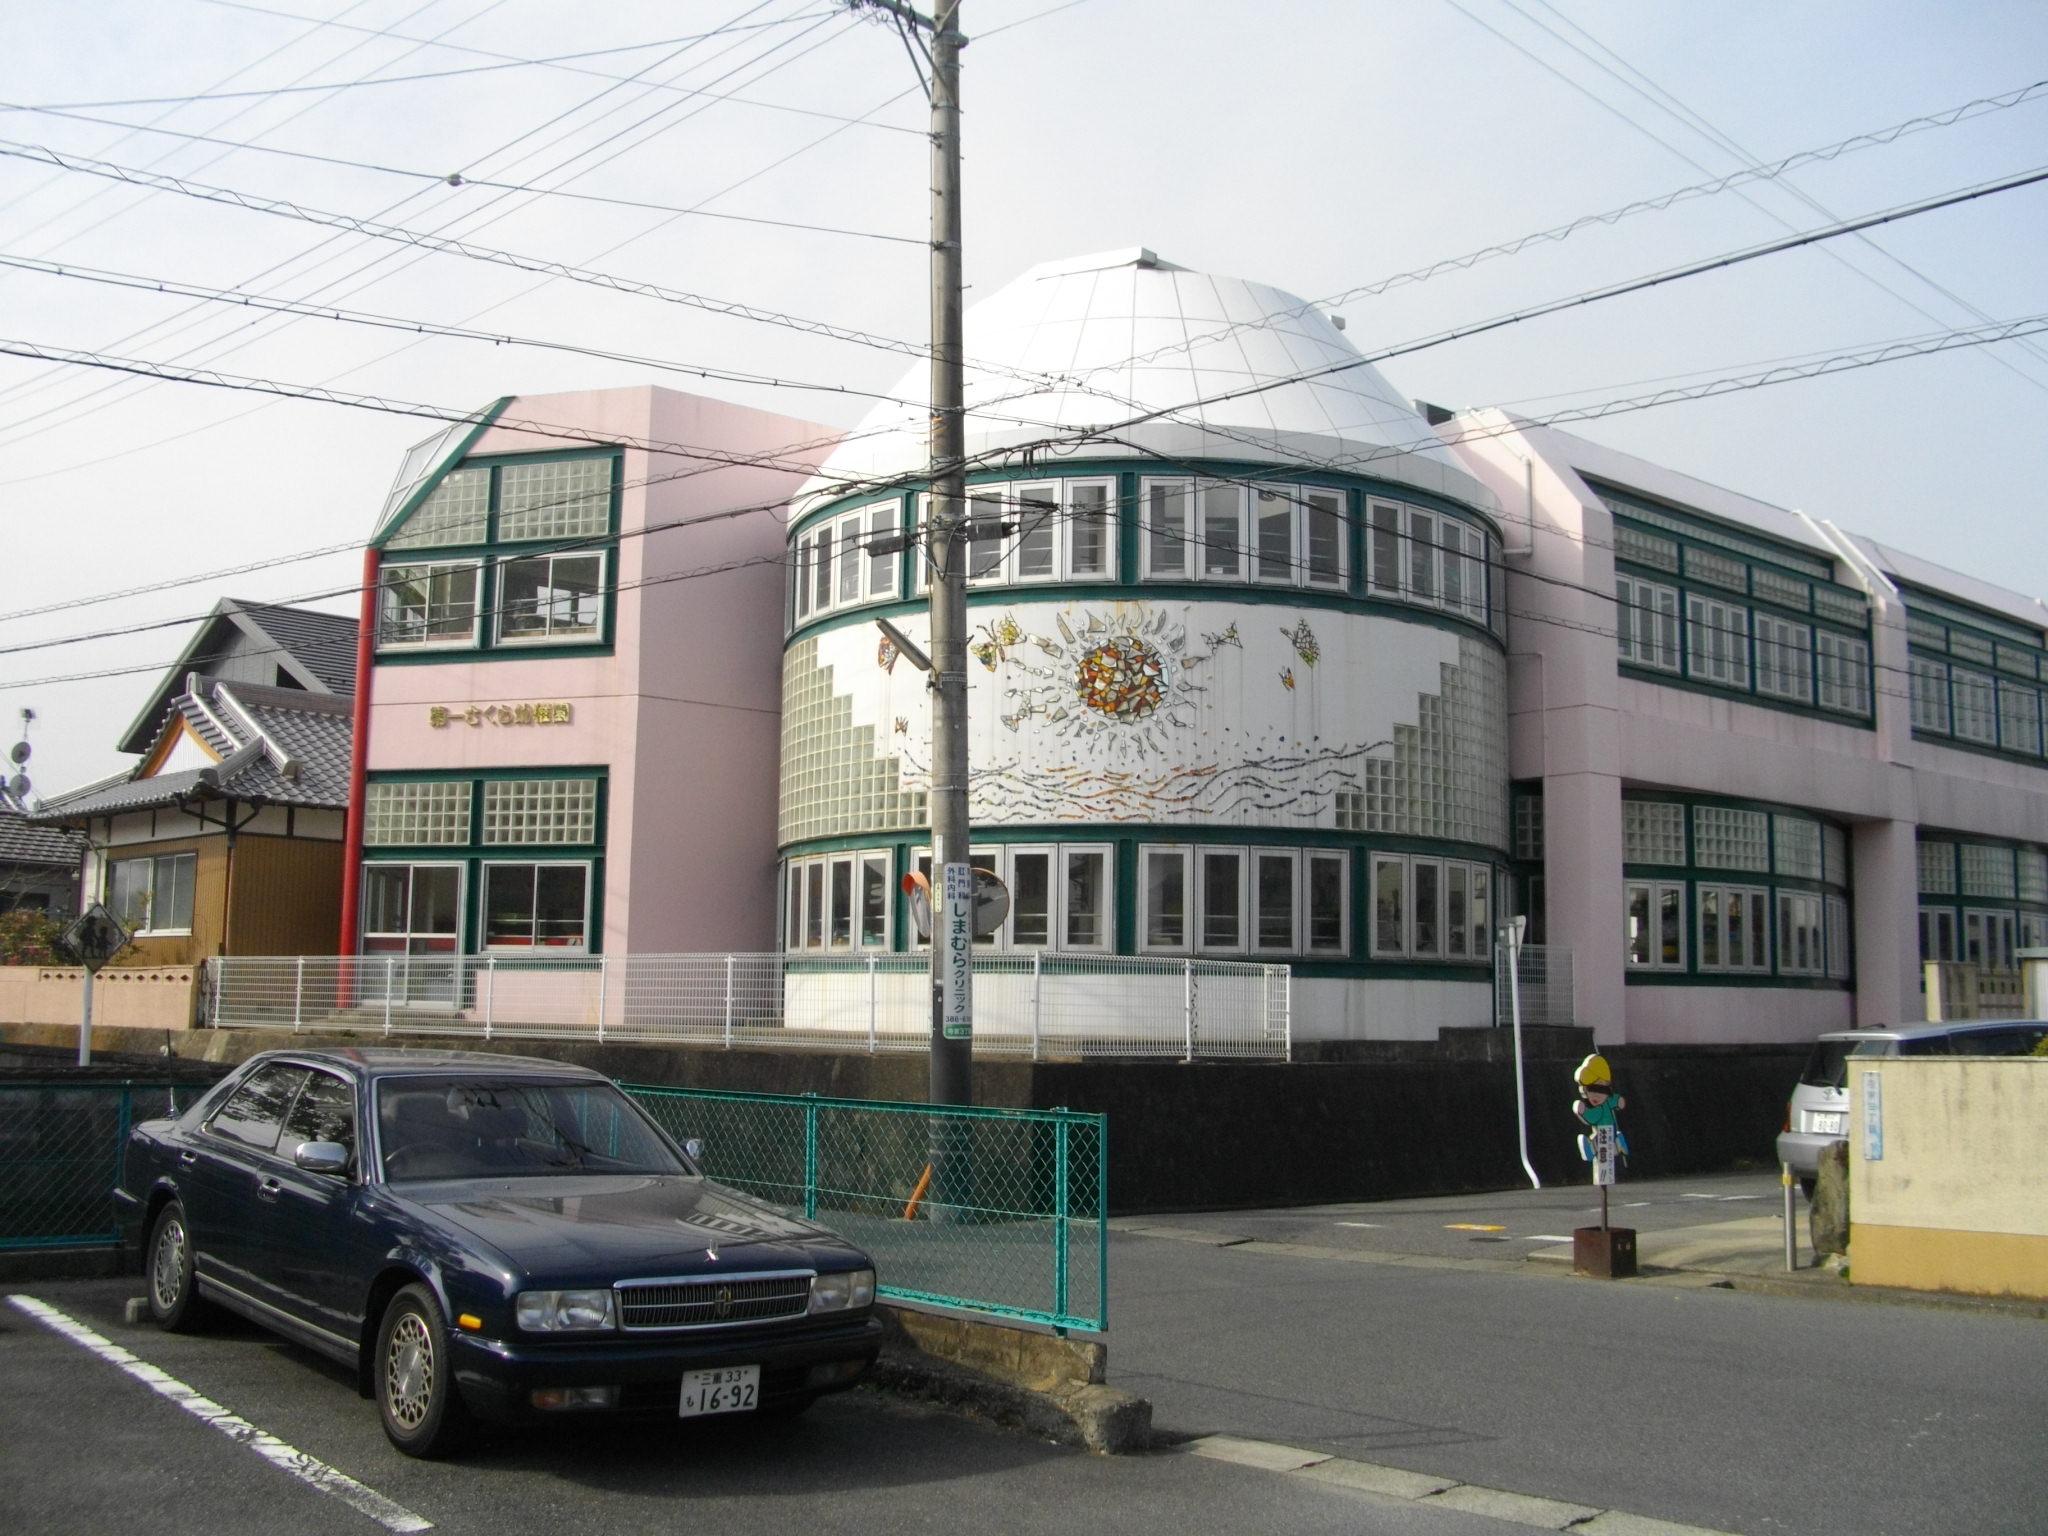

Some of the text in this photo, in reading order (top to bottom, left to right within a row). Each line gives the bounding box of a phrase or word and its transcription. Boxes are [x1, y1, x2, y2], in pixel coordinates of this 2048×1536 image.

[430, 702, 571, 728] 第一さくら幼稚園
[947, 866, 956, 900] 外科内科
[951, 902, 968, 1014] しまむらクリニック
[700, 1370, 742, 1386] 三重 33
[700, 1384, 755, 1412] 16-92
